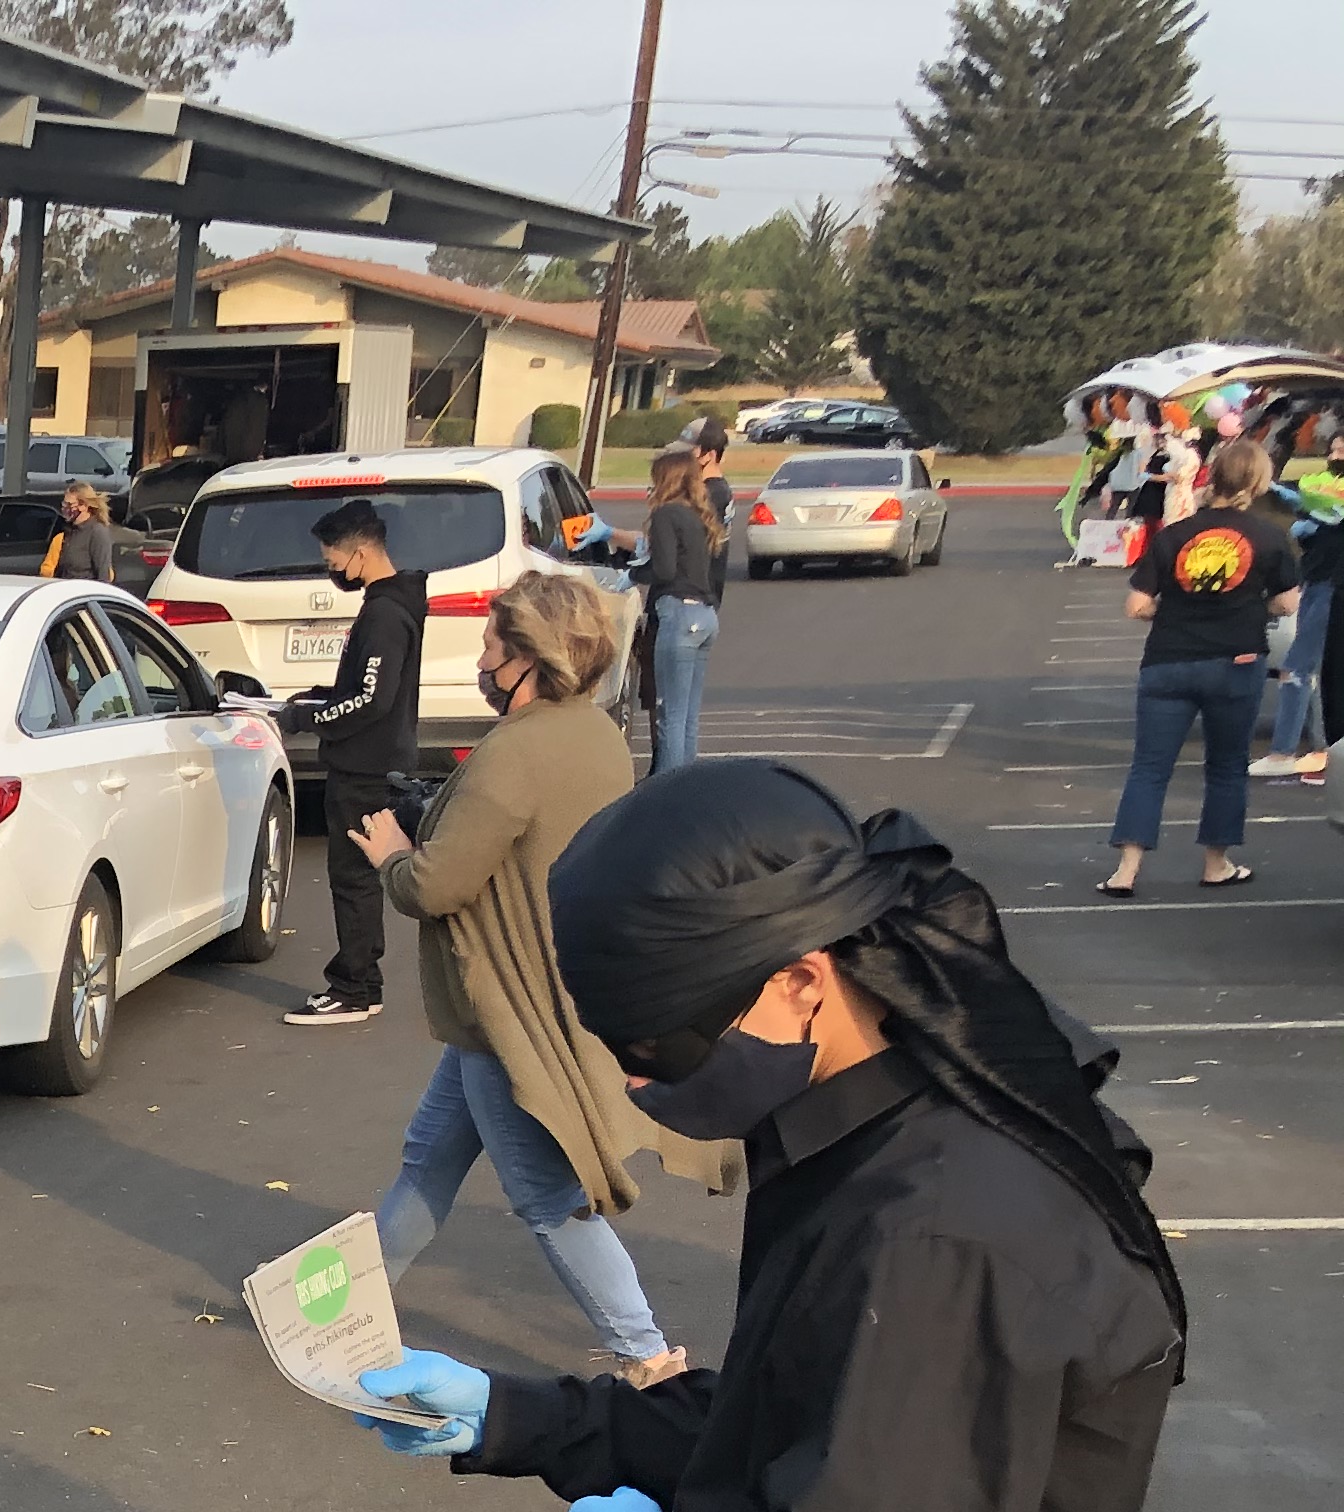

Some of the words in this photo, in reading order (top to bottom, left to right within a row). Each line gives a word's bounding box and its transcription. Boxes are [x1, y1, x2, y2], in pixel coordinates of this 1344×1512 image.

[291, 639, 343, 655] 8JYA67
[295, 1279, 311, 1308] RHS
[306, 1269, 332, 1301] HIKING
[328, 1261, 347, 1290] CLUB
[304, 1313, 373, 1360] @rhs.hikingclub
